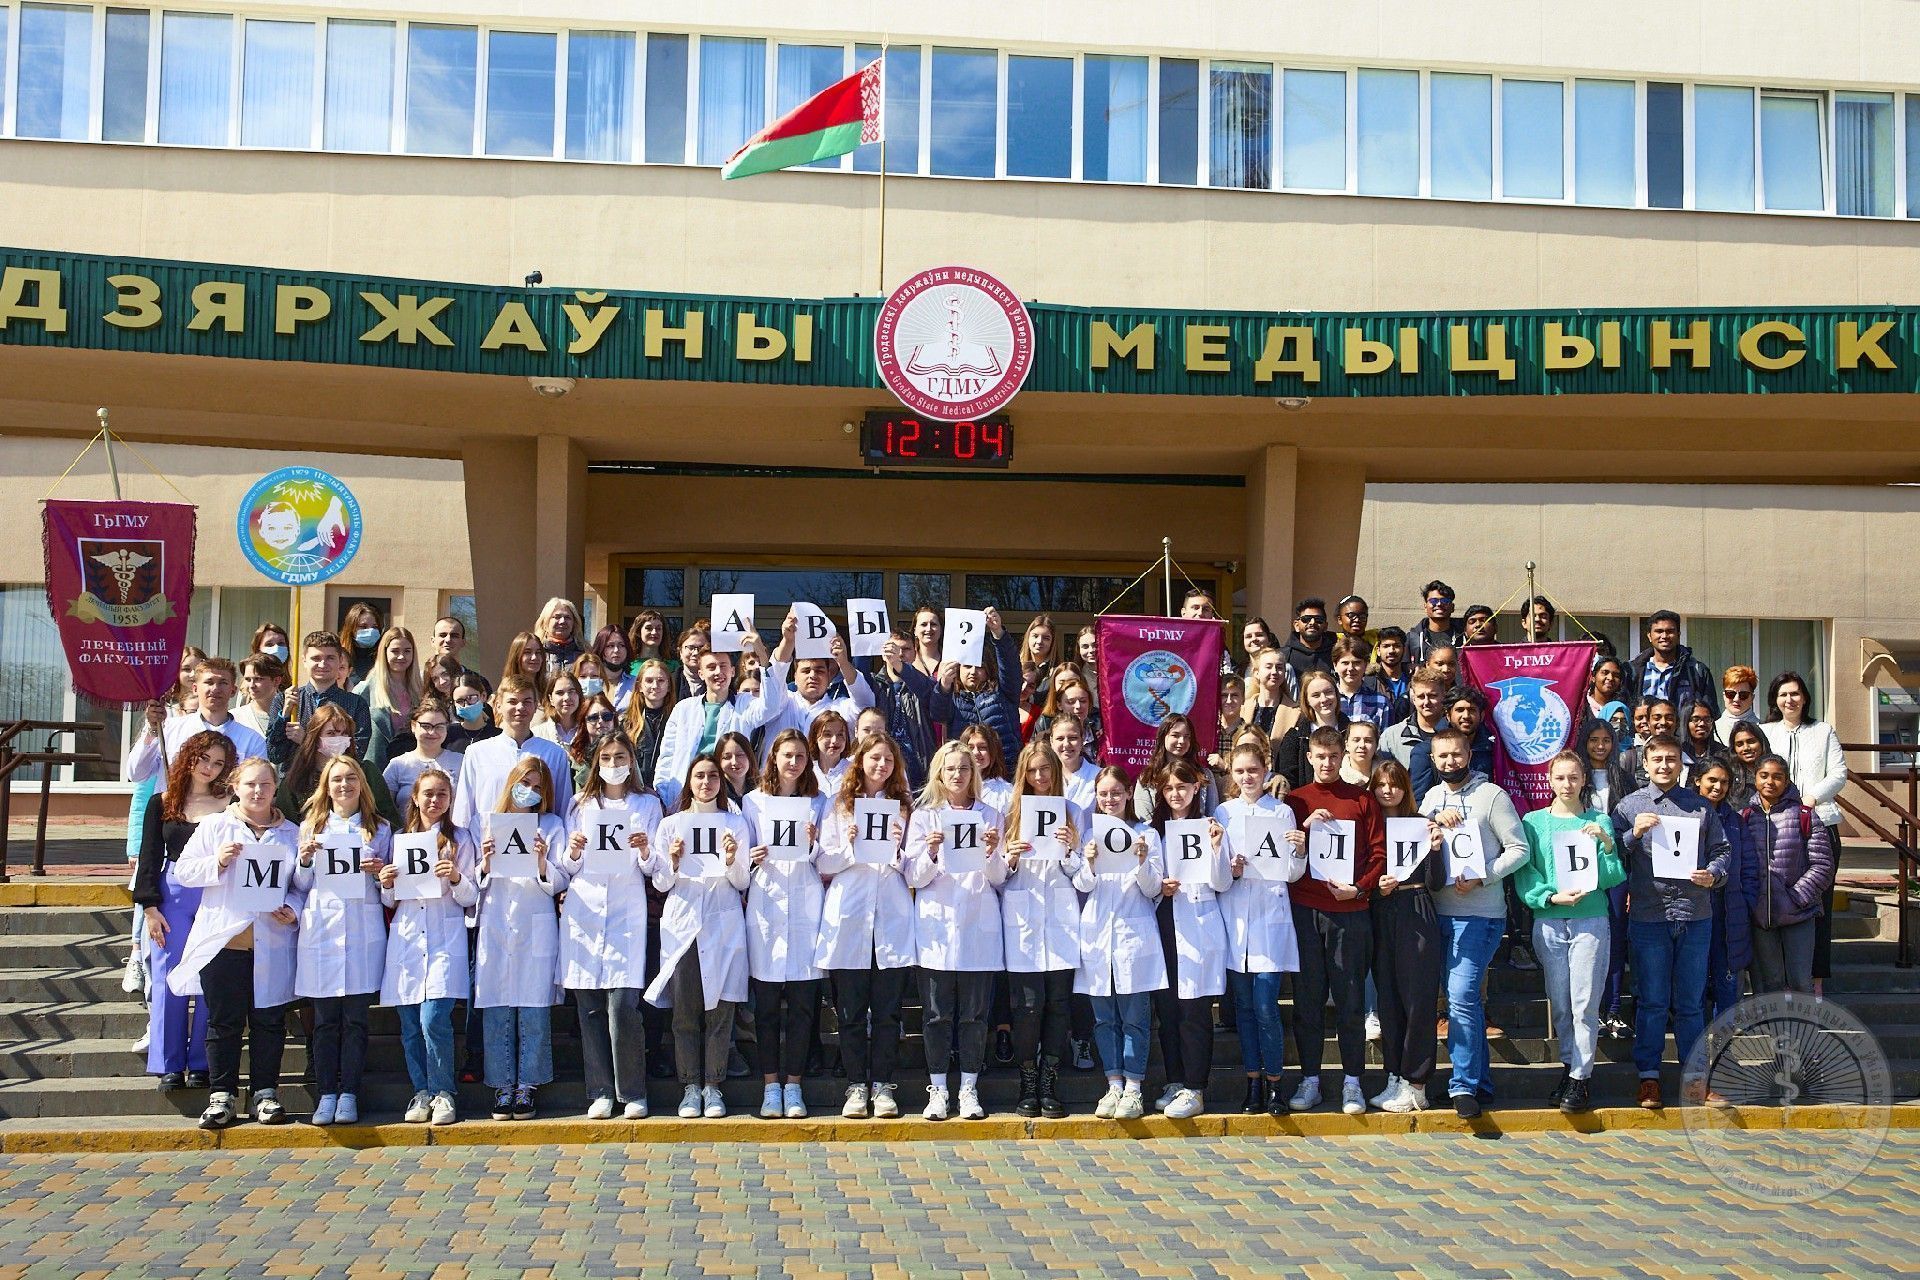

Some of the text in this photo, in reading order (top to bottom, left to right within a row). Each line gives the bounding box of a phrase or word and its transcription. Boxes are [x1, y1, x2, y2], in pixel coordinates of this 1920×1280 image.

[0, 266, 1898, 382] ДЗЯРЖАЎНЫ МЕДЫЦЫНСК
[892, 374, 916, 402] Grodno
[916, 396, 939, 413] State
[941, 405, 975, 416] Medical
[927, 377, 988, 399] ГДМУ
[93, 513, 150, 528] ГрГМУ
[281, 571, 319, 584] ГДМУ
[113, 614, 139, 625] 1958
[1138, 628, 1186, 642] ГрГМУ
[80, 638, 167, 652] ЛЕЧЕБНЫЙ
[79, 653, 169, 666] ФАКУЛЬТЕТ
[1504, 655, 1555, 669] ГрГМУ
